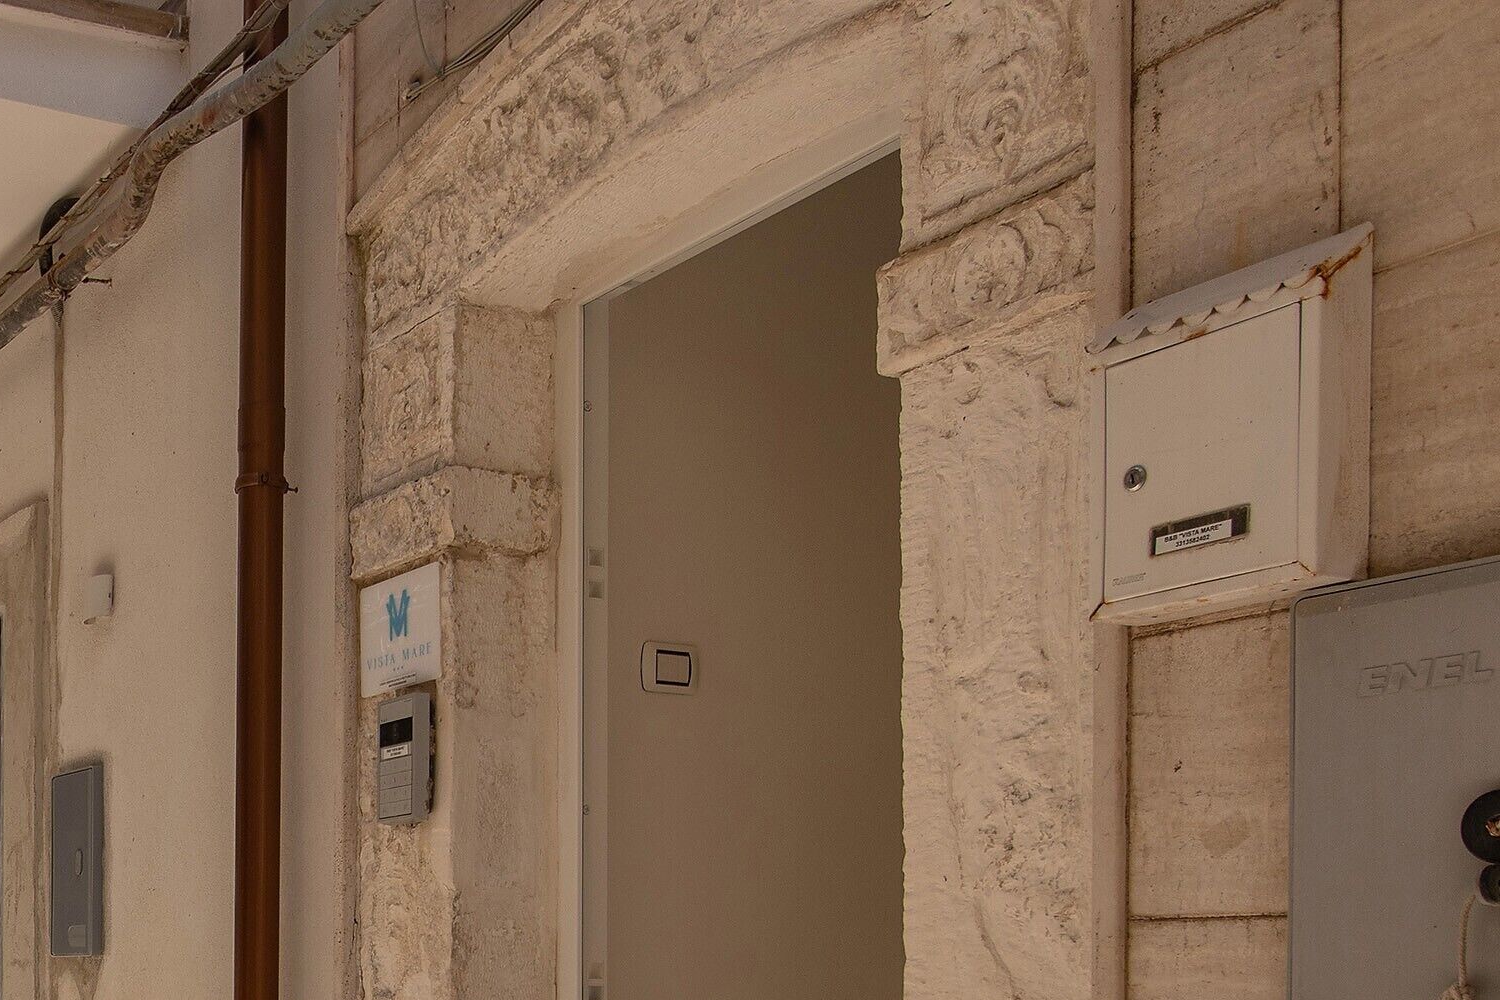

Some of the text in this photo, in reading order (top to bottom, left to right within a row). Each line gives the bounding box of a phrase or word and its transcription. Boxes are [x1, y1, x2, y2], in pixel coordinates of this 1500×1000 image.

[366, 642, 431, 671] VISTA MARE
[1358, 650, 1494, 698] ENEL
